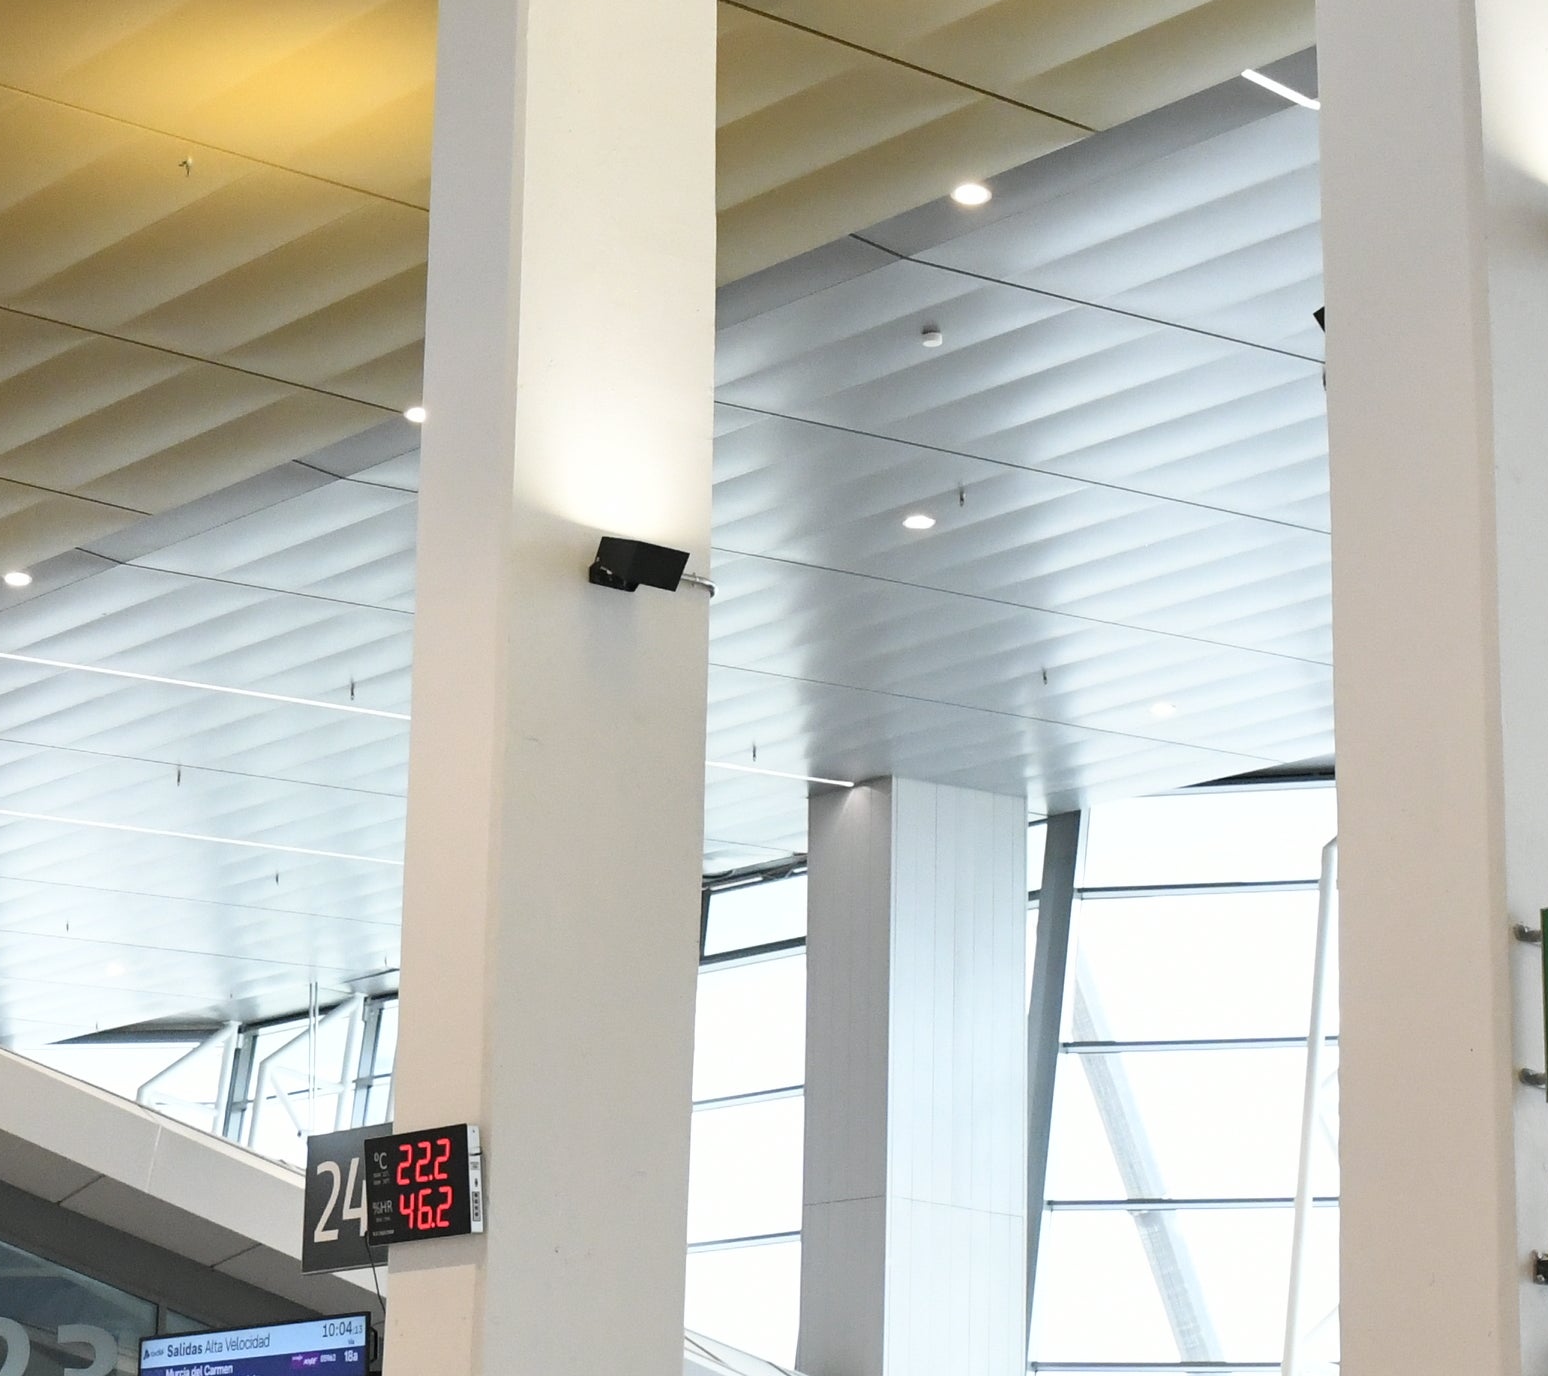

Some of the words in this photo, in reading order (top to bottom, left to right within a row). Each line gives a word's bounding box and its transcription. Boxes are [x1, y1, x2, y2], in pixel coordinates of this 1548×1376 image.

[396, 1138, 451, 1186] 22.2
[314, 1157, 368, 1243] 24
[399, 1185, 452, 1230] 46.2
[167, 1343, 203, 1358] Salidas
[204, 1339, 223, 1354] Alta
[224, 1332, 271, 1352] Velocidad
[344, 1350, 359, 1362] 18a
[191, 1366, 203, 1376] del
[204, 1364, 234, 1376] Carmen
